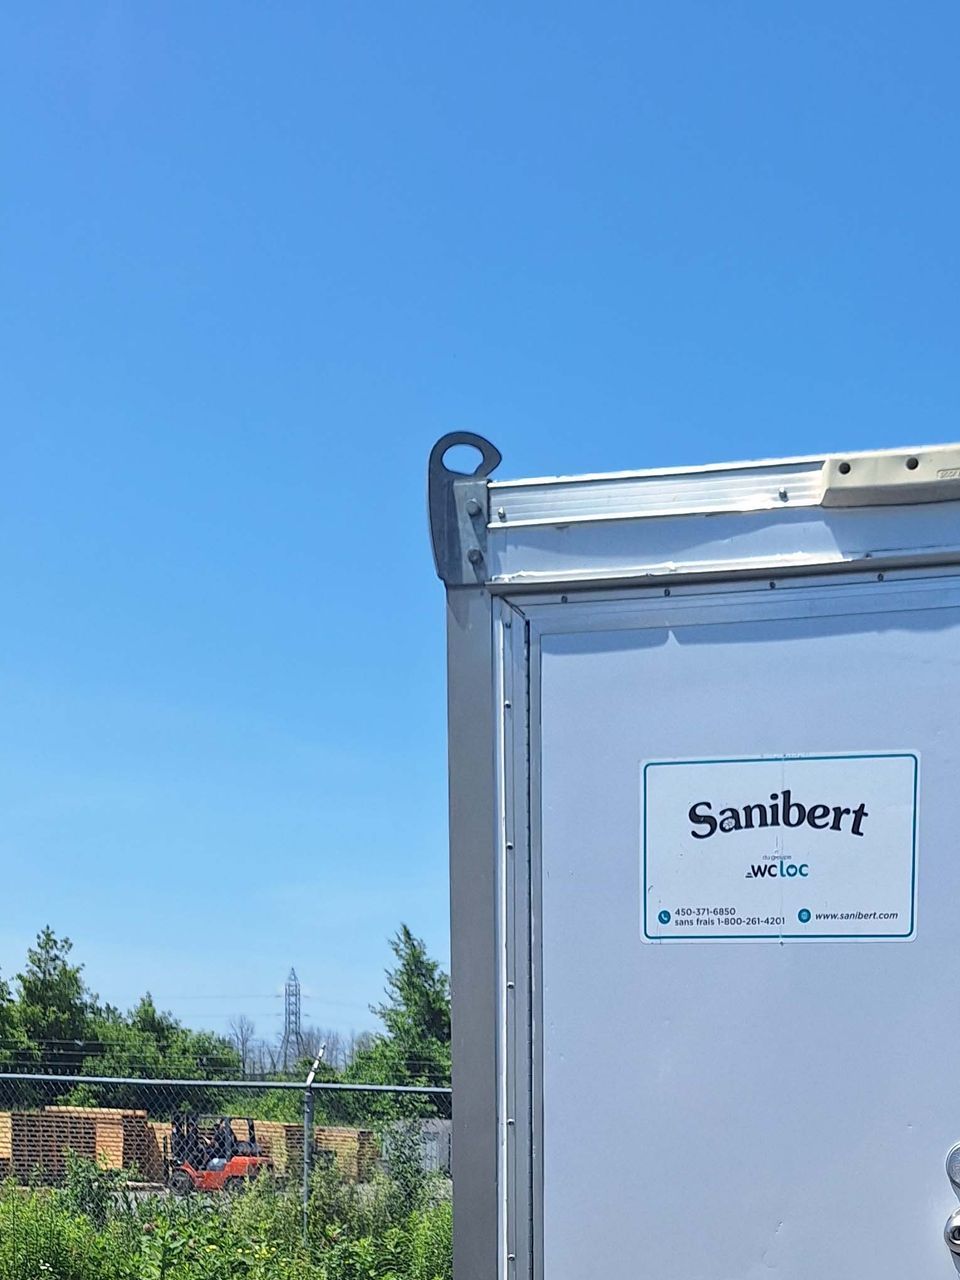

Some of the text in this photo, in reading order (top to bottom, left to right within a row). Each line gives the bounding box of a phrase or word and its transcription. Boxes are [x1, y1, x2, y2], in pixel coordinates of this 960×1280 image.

[688, 789, 869, 839] Sanibert
[674, 907, 736, 916] 450-371-6850
[815, 911, 899, 920] www.sanibert.com
[674, 917, 785, 926] sans frais 1-800-261-4201
